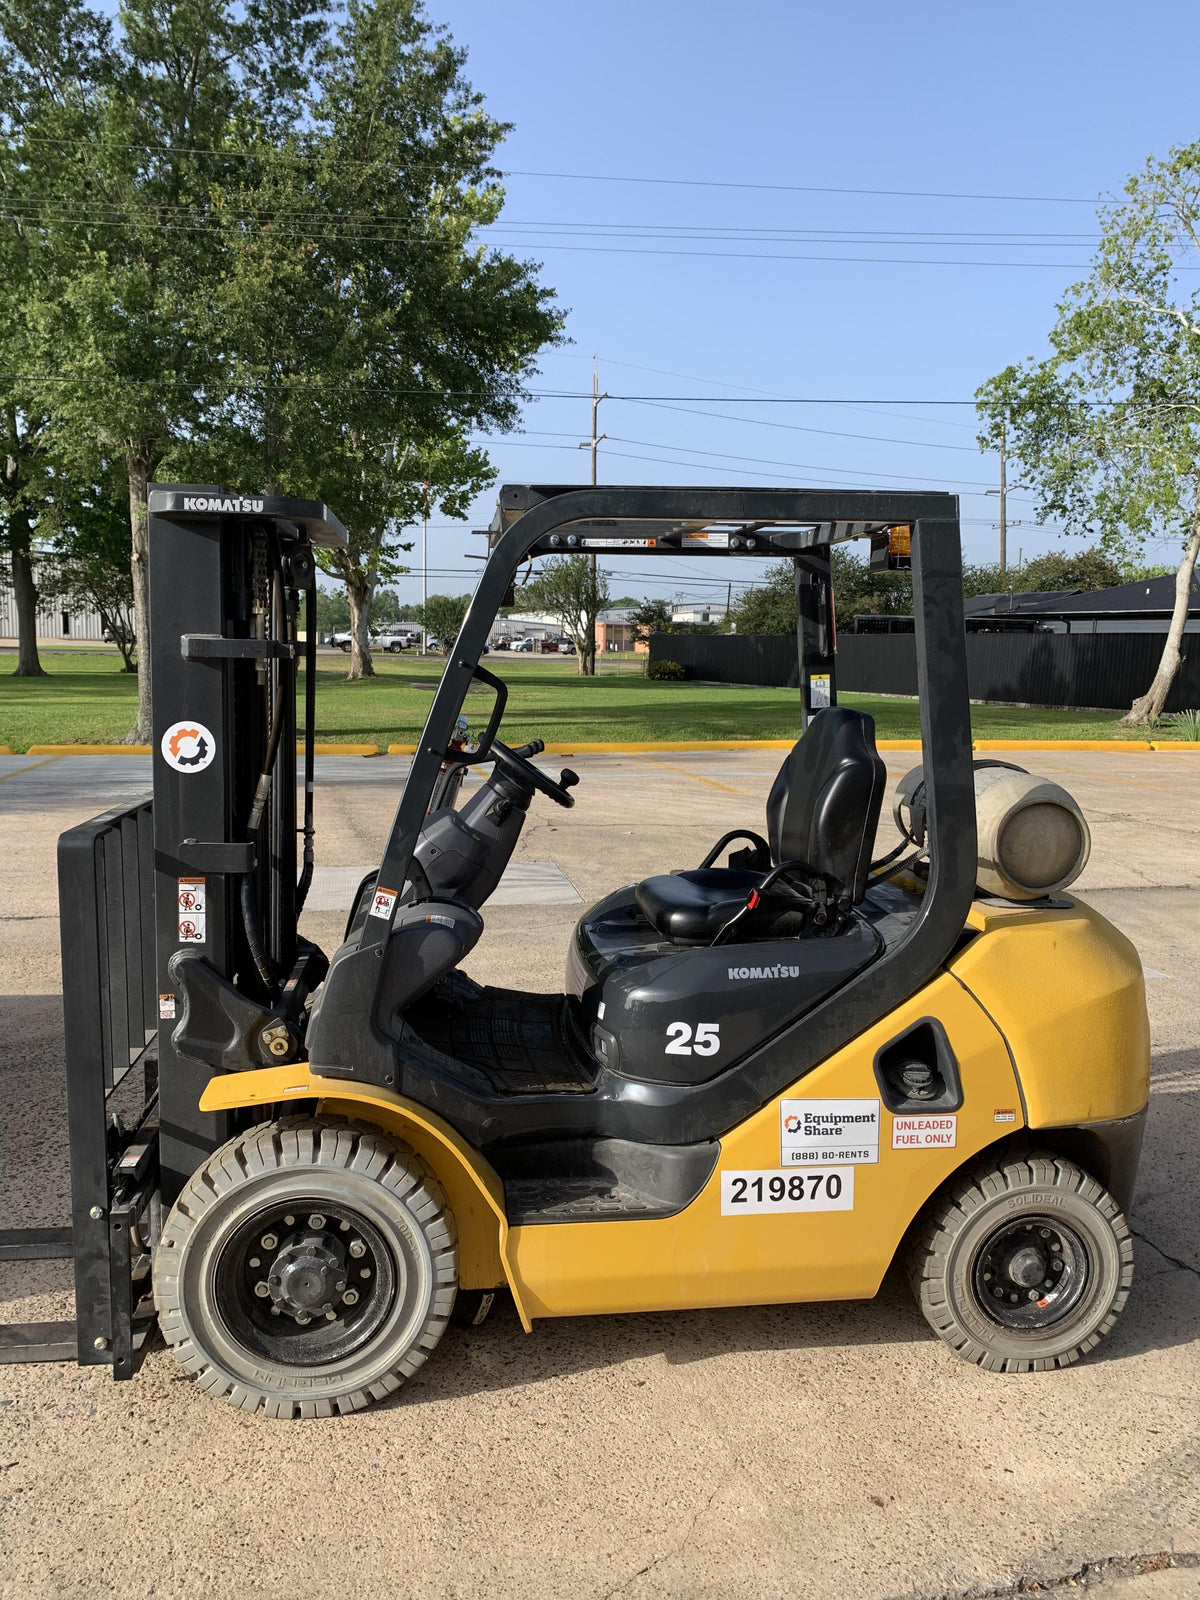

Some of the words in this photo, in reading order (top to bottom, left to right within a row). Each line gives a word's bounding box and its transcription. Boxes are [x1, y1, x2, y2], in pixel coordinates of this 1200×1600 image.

[184, 496, 264, 513] KOMATSU
[728, 963, 800, 980] KOMATSU
[664, 1021, 721, 1057] 25
[803, 1112, 876, 1125] Equipment
[896, 1120, 953, 1131] UNLEADED
[803, 1125, 843, 1136] Share
[896, 1135, 922, 1145] FUEL
[925, 1134, 953, 1144] ONLY
[791, 1152, 819, 1161] (888)
[821, 1150, 870, 1160] 80-RENTS
[730, 1174, 842, 1204] 219870
[1007, 1193, 1066, 1209] SOLIDEAL
